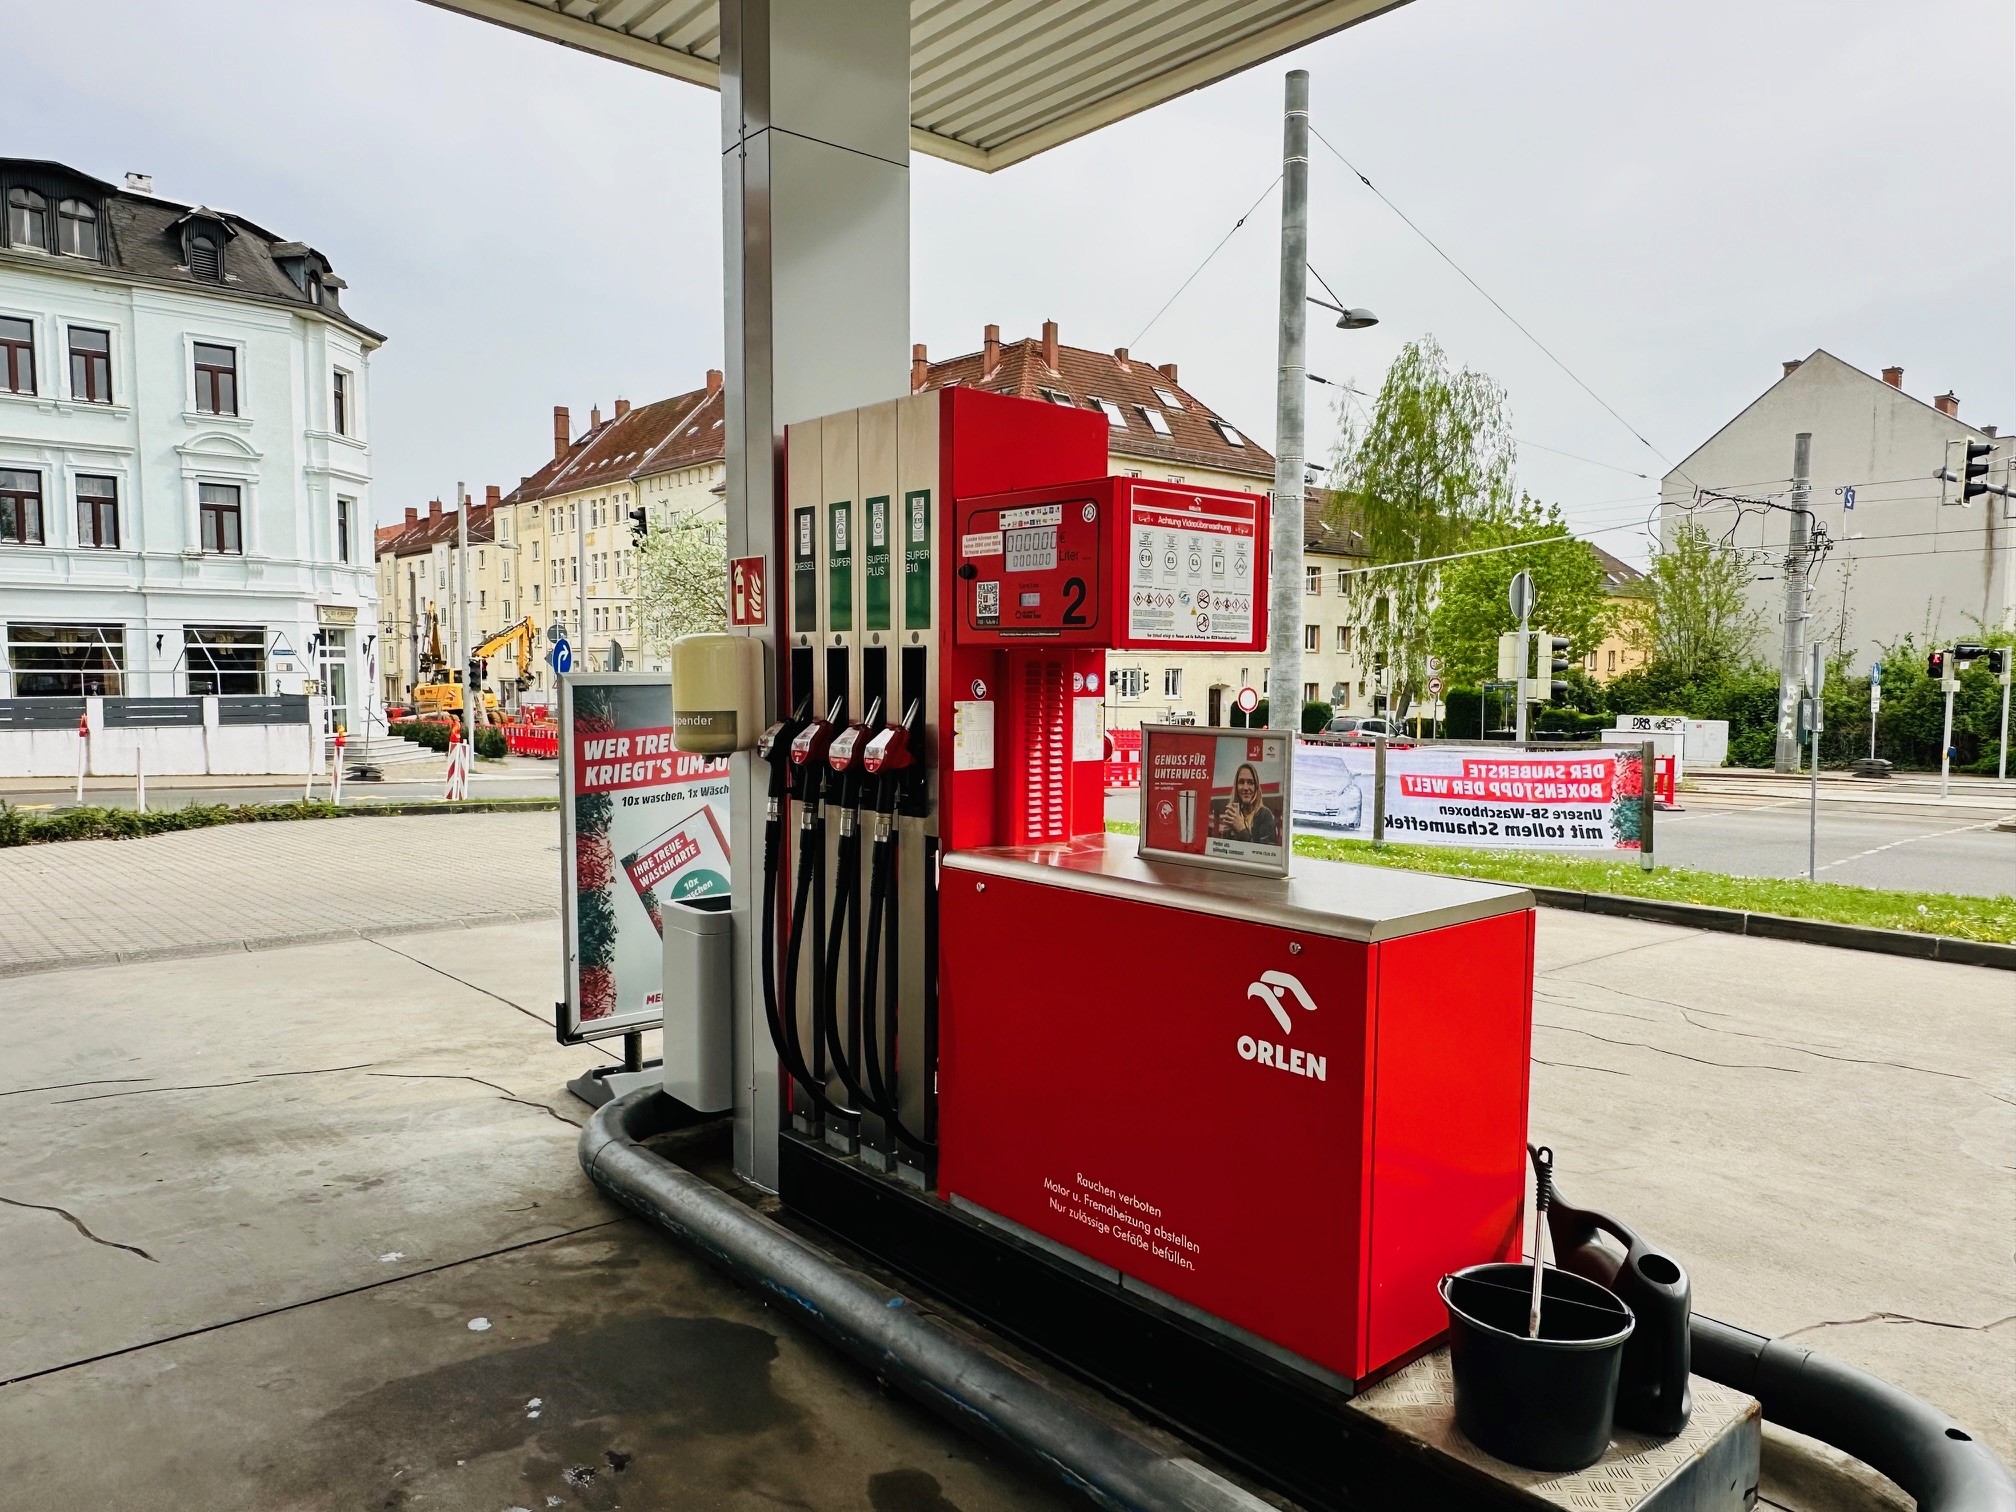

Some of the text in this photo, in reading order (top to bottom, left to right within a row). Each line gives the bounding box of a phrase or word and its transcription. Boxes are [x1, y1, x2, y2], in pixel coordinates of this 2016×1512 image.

[1157, 516, 1232, 533] Achtung Videoüberwachung
[830, 557, 851, 568] SUPER
[867, 554, 890, 565] SUPER
[906, 550, 930, 561] SUPER
[1059, 550, 1080, 562] Liter
[795, 562, 815, 571] DIESEL
[867, 567, 885, 576] PLUS
[906, 562, 919, 573] E10
[1062, 577, 1087, 625] 2
[584, 738, 630, 761] WER
[1154, 752, 1206, 766] GENUSS FÜR
[585, 758, 671, 787] KRIEGT'S
[1154, 768, 1210, 780] UNTERWEGS.
[621, 795, 640, 807] 10x
[641, 791, 685, 805] waschen,
[687, 788, 698, 799] 1x
[633, 838, 684, 877] IHRE TREUE-
[639, 843, 697, 888] WASCHKARTE
[684, 877, 699, 891] 10x
[1237, 1035, 1326, 1082] ORLEN
[1077, 1172, 1162, 1218] Rauchen verboten
[1044, 1177, 1200, 1254] Motor u. Fremdheizung abstellen
[1050, 1197, 1195, 1271] Nur zulässige Gefäße befüllen.
